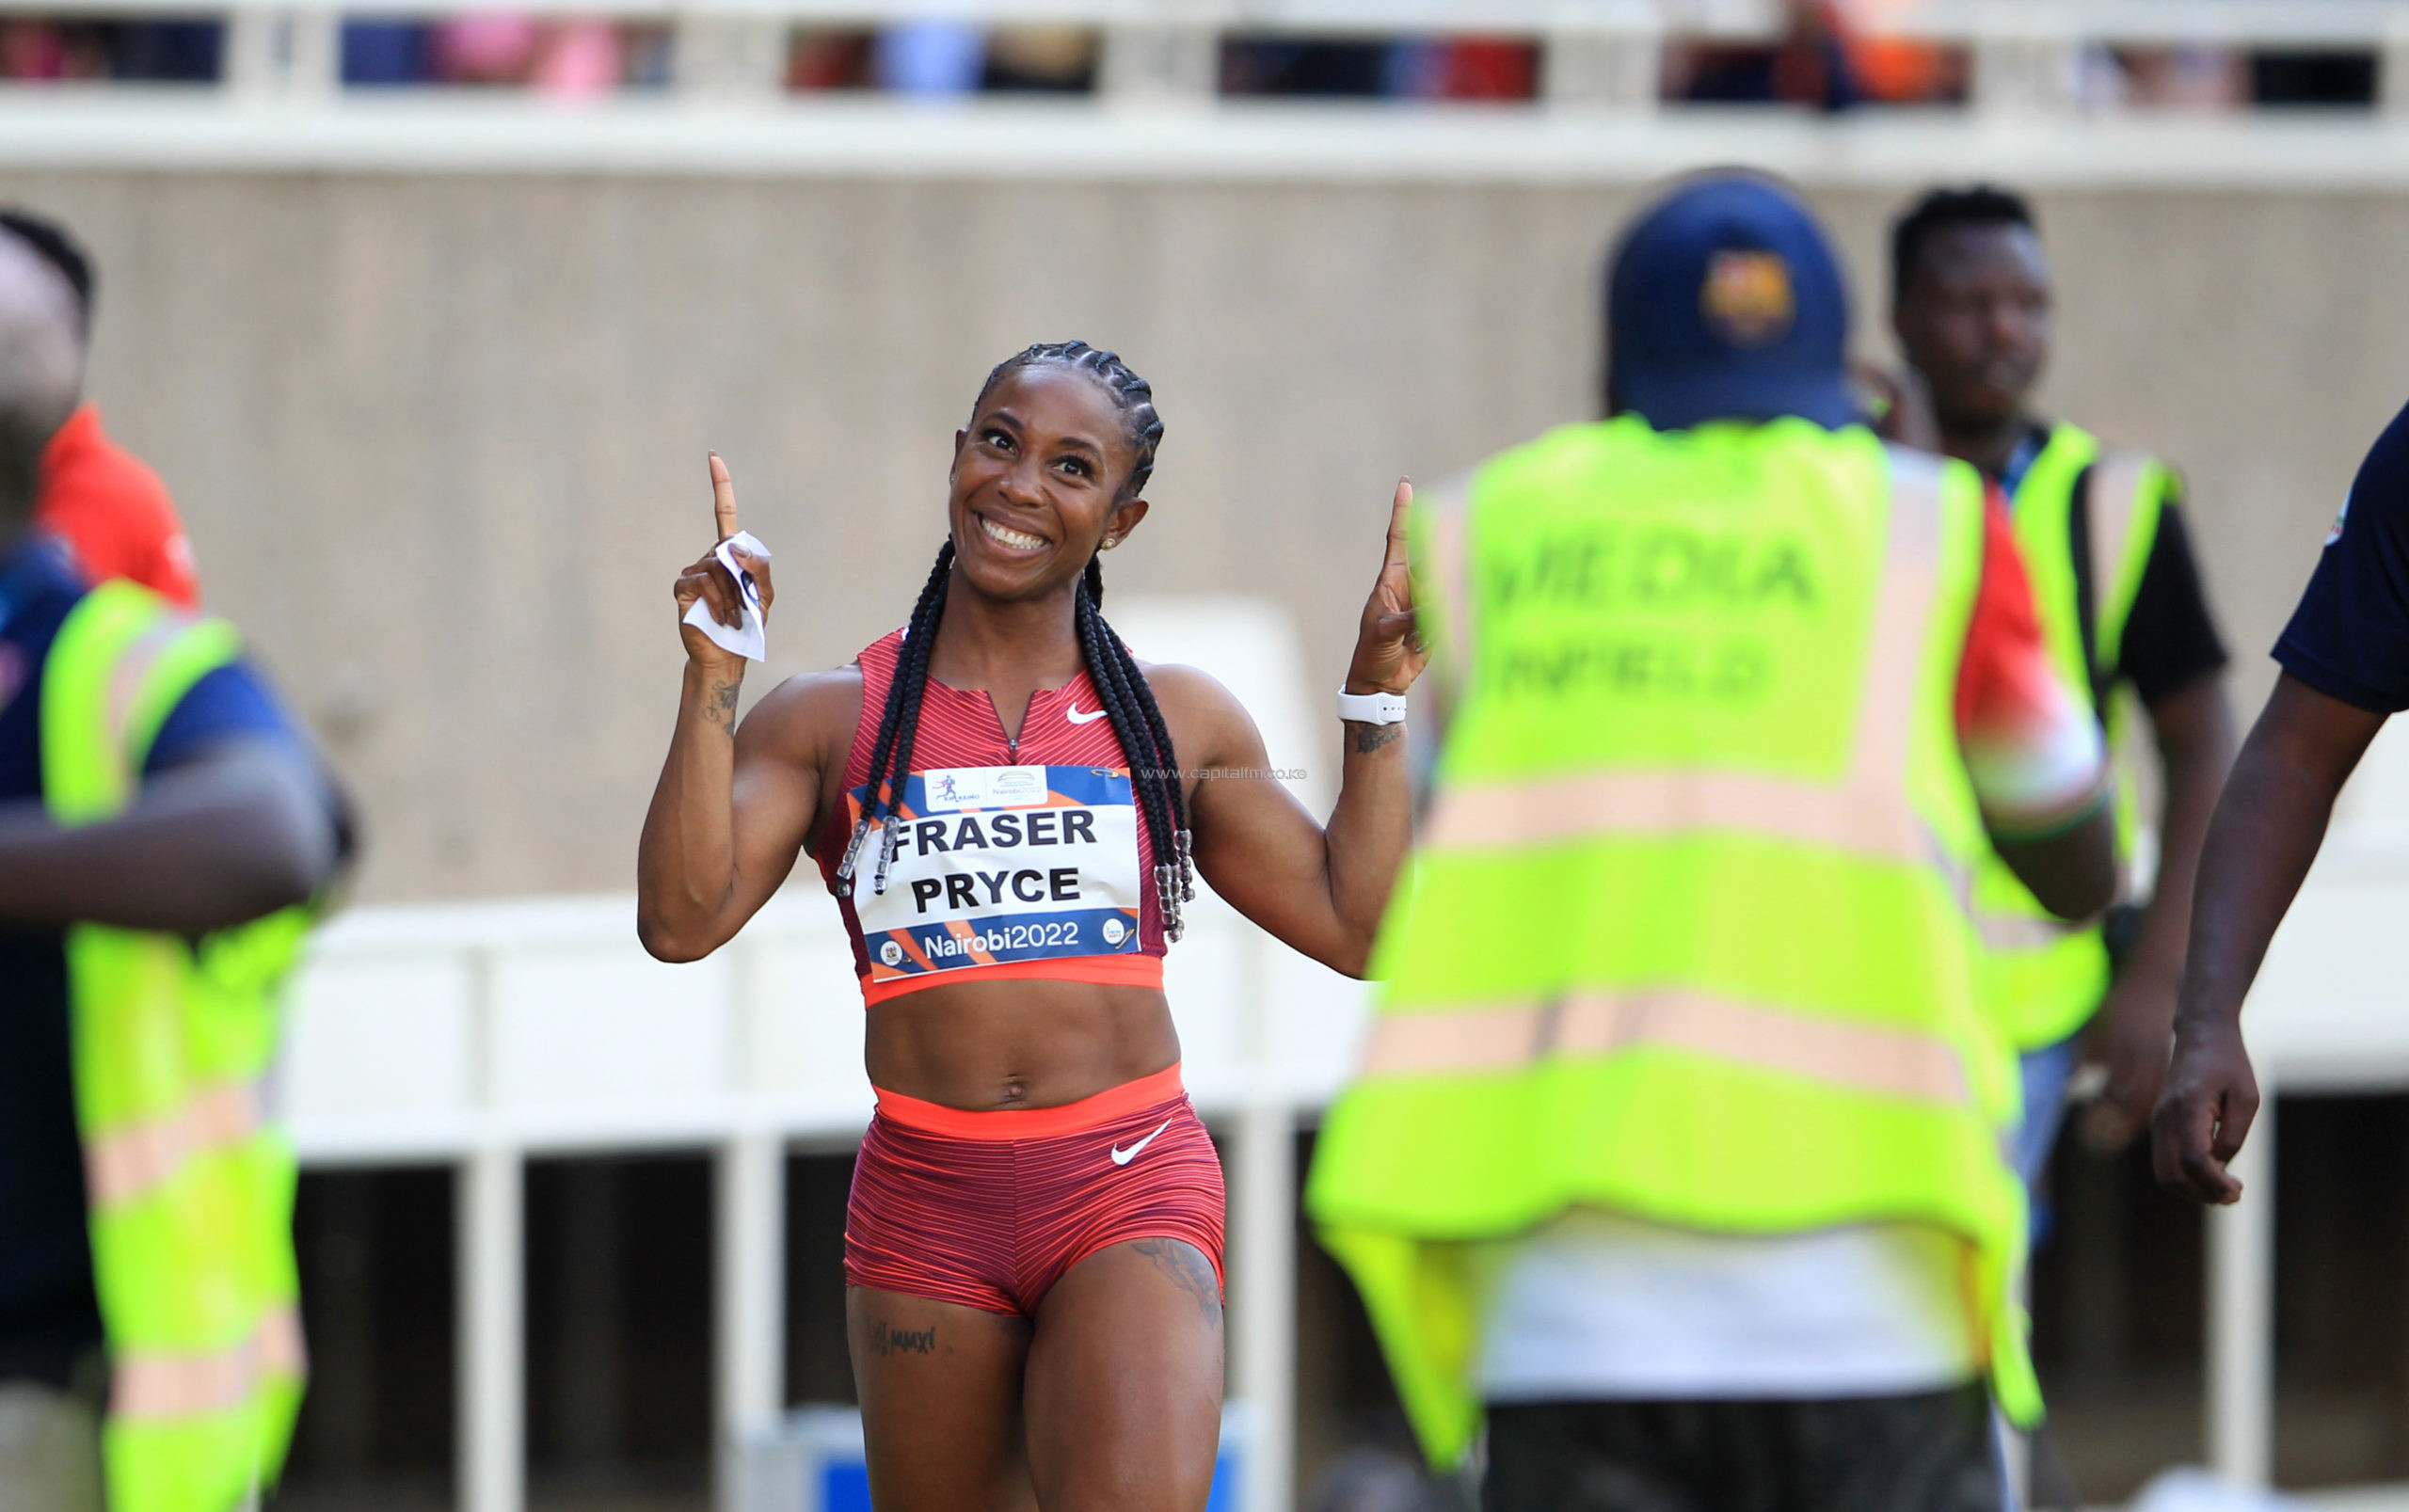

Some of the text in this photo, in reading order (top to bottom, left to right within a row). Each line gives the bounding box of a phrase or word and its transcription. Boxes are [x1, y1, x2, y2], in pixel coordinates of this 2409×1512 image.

[891, 810, 1097, 863] FRASER
[911, 867, 1081, 913] PRYCE
[924, 921, 1079, 960] Nairobi2022
